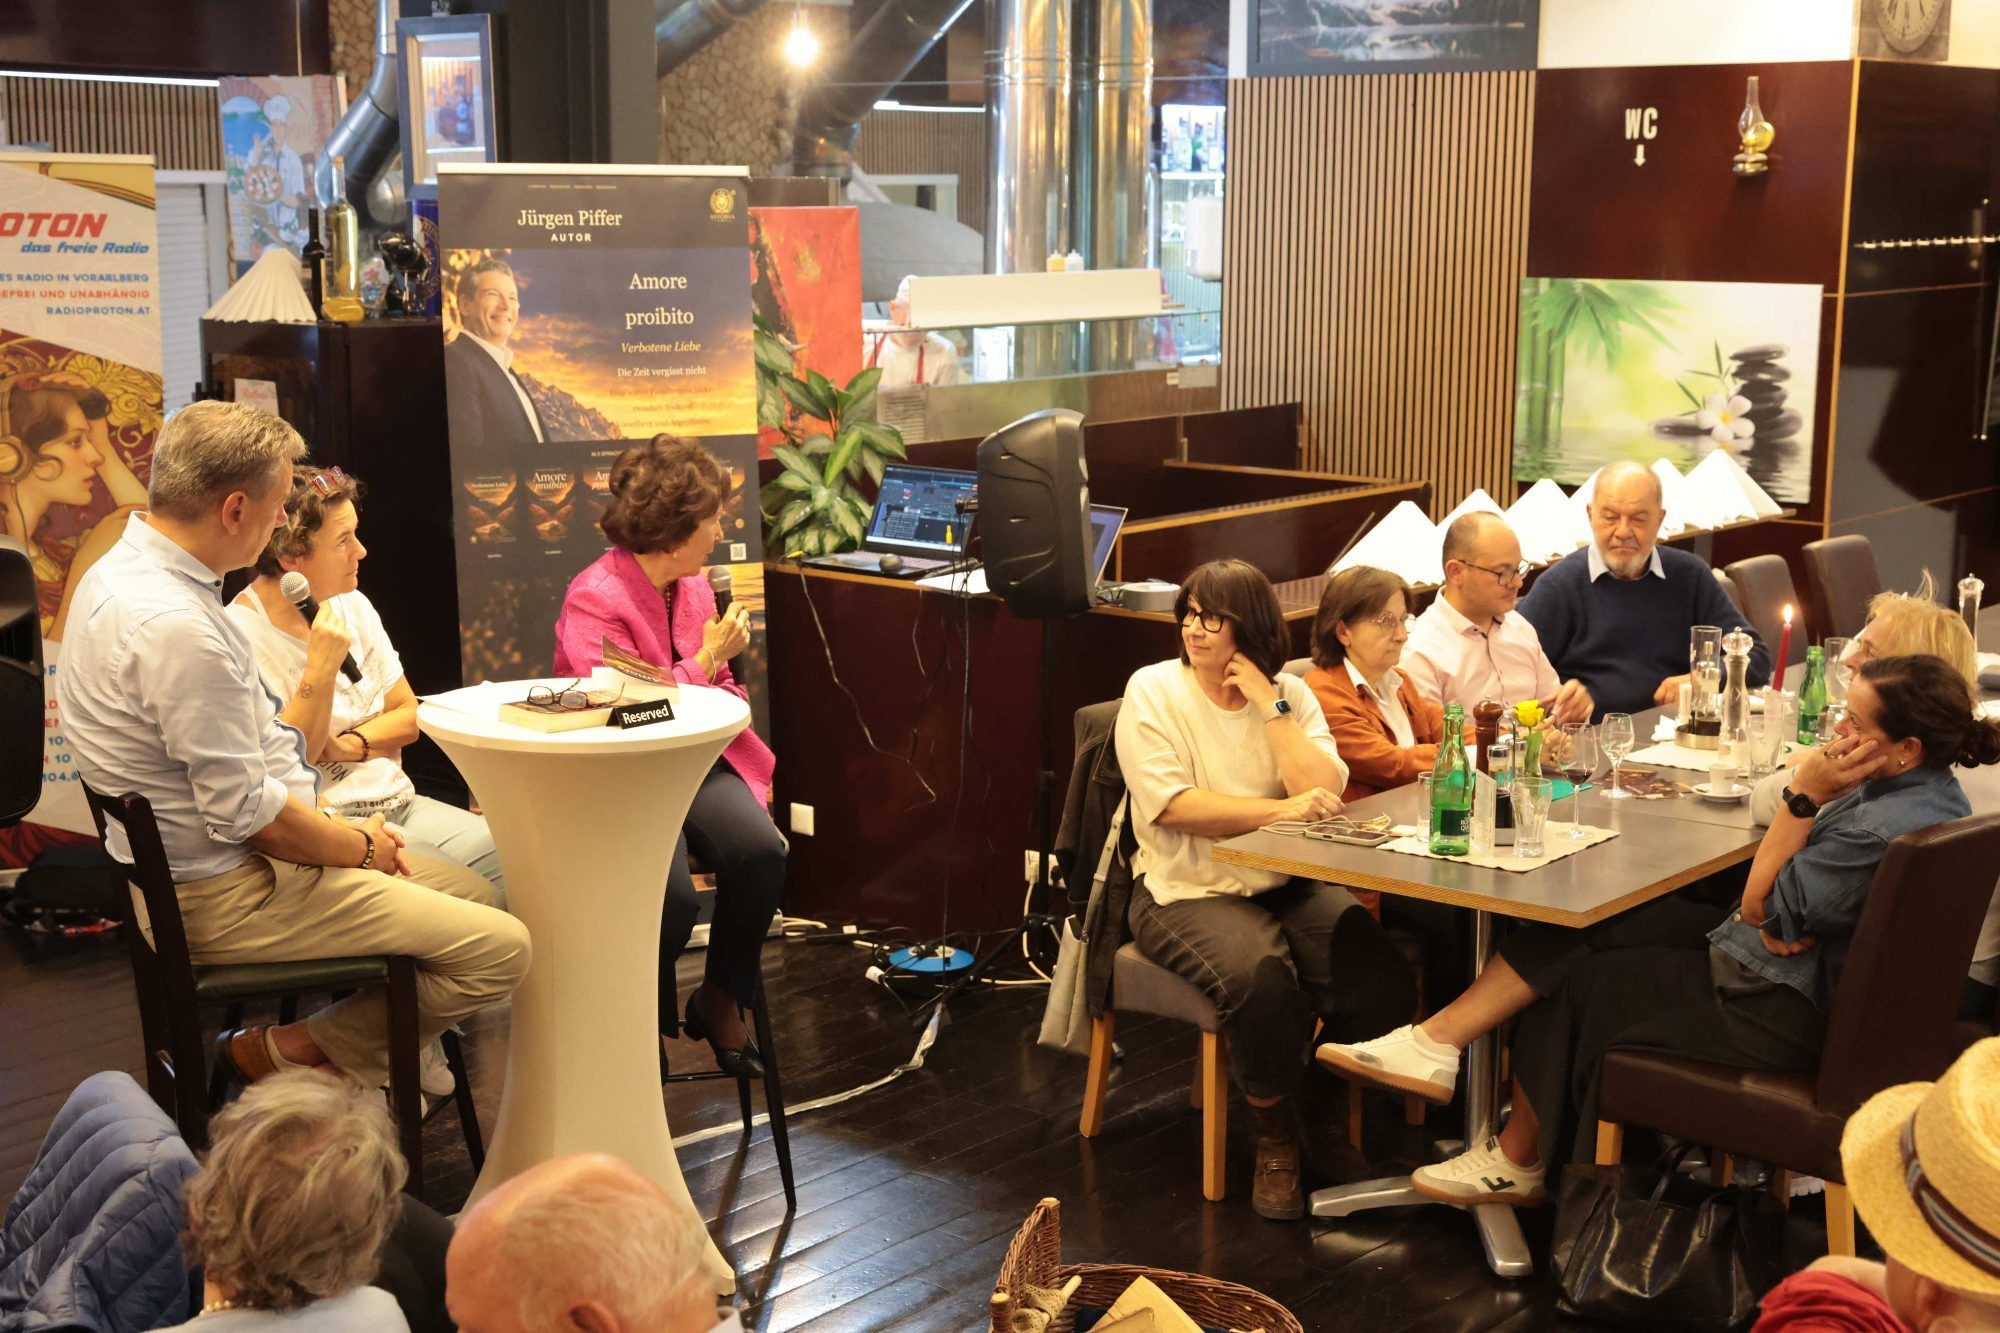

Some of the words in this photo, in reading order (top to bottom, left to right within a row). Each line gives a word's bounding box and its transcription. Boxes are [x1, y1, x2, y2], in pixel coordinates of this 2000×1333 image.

[1625, 107, 1658, 139] WC
[517, 209, 574, 229] Jürgen
[578, 209, 622, 226] Piffer
[551, 233, 592, 241] AUTOR
[21, 241, 52, 253] das
[56, 242, 98, 253] freie
[102, 242, 149, 254] Radio
[17, 274, 54, 282] RADIO
[57, 274, 69, 282] IN
[73, 274, 149, 282] VORARLBERG
[629, 272, 687, 289] Amore
[0, 290, 35, 298] EFREI
[40, 290, 65, 298] UND
[70, 288, 150, 298] UNABHÄNGIG
[46, 307, 150, 315] RADIOPROTON.AT
[625, 307, 694, 330] proibito
[621, 342, 672, 353] Verbotene
[674, 341, 701, 352] Liebe
[617, 368, 632, 377] Die
[633, 367, 650, 377] Zeit
[652, 366, 684, 377] vergisst
[685, 365, 707, 375] nicht
[533, 472, 567, 482] Amore
[622, 704, 670, 725] Reserved
